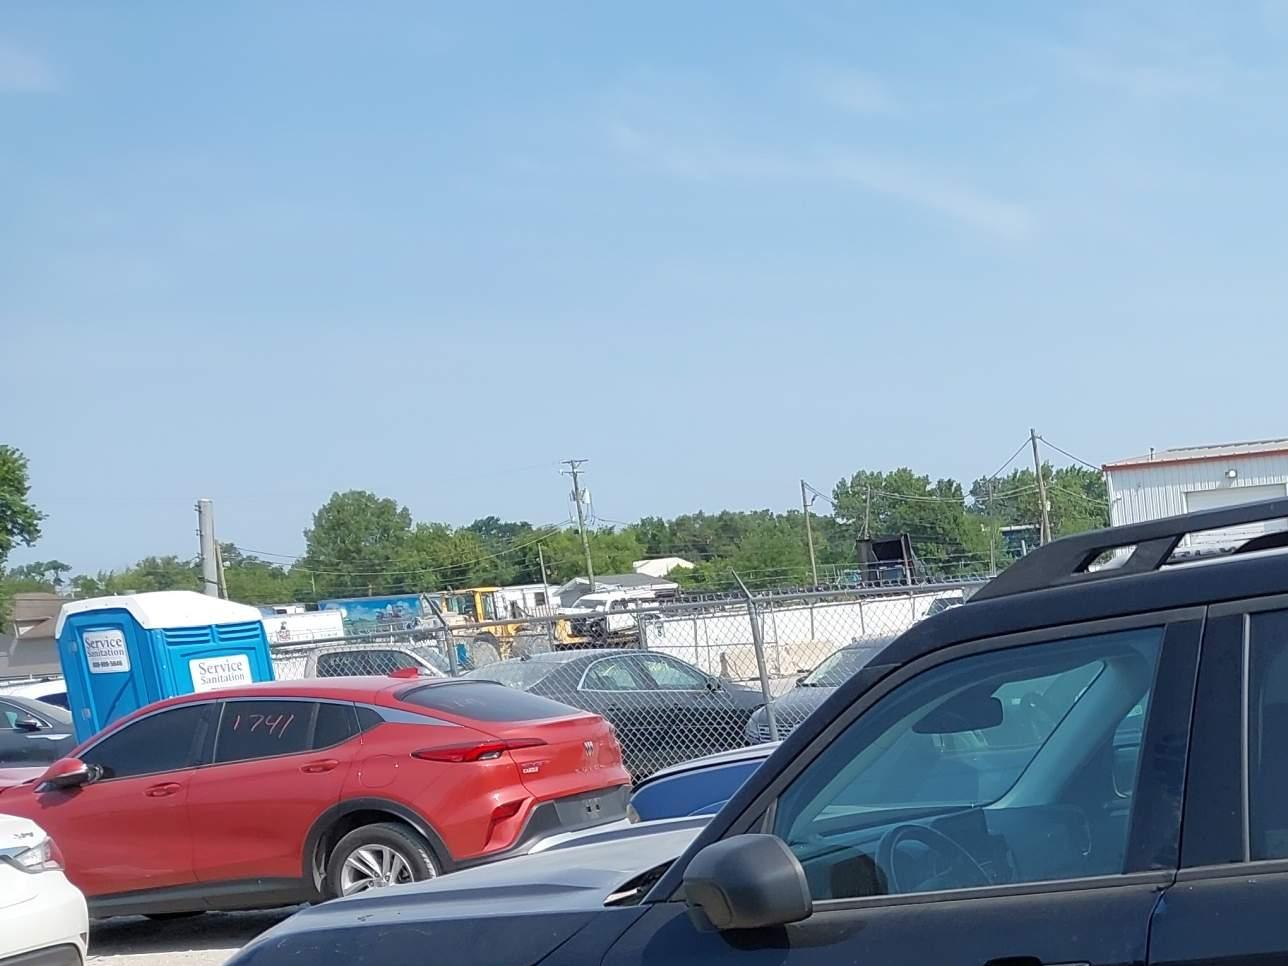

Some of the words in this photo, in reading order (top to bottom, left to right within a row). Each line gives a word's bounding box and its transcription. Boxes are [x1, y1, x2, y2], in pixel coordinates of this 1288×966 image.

[85, 636, 122, 649] Service
[88, 649, 124, 657] Sanitation
[198, 659, 243, 675] Service
[200, 673, 245, 685] Sanitation
[233, 714, 294, 738] 1741
